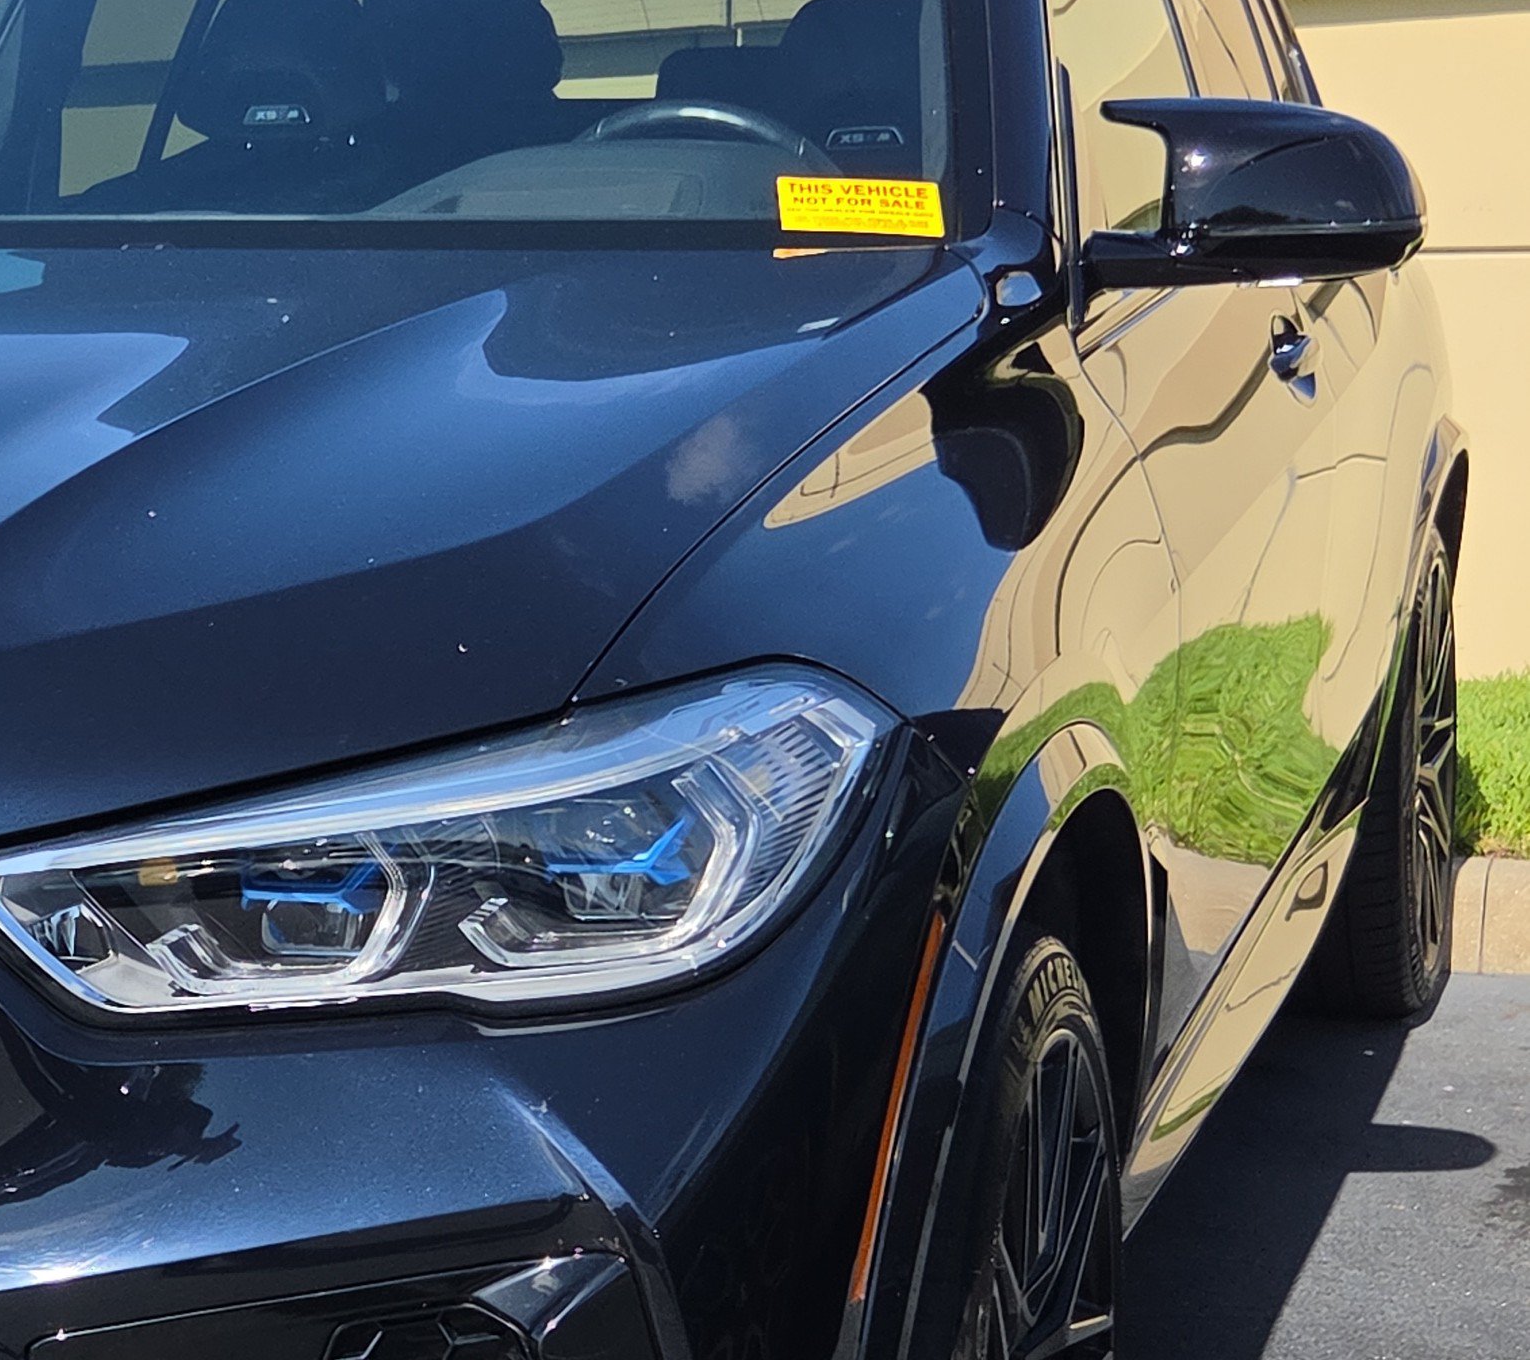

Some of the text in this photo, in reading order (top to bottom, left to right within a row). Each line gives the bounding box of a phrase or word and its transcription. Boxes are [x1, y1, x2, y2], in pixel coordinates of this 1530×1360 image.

[788, 182, 929, 200] THIS VEHICLE
[793, 196, 926, 210] NOT FOR SALE
